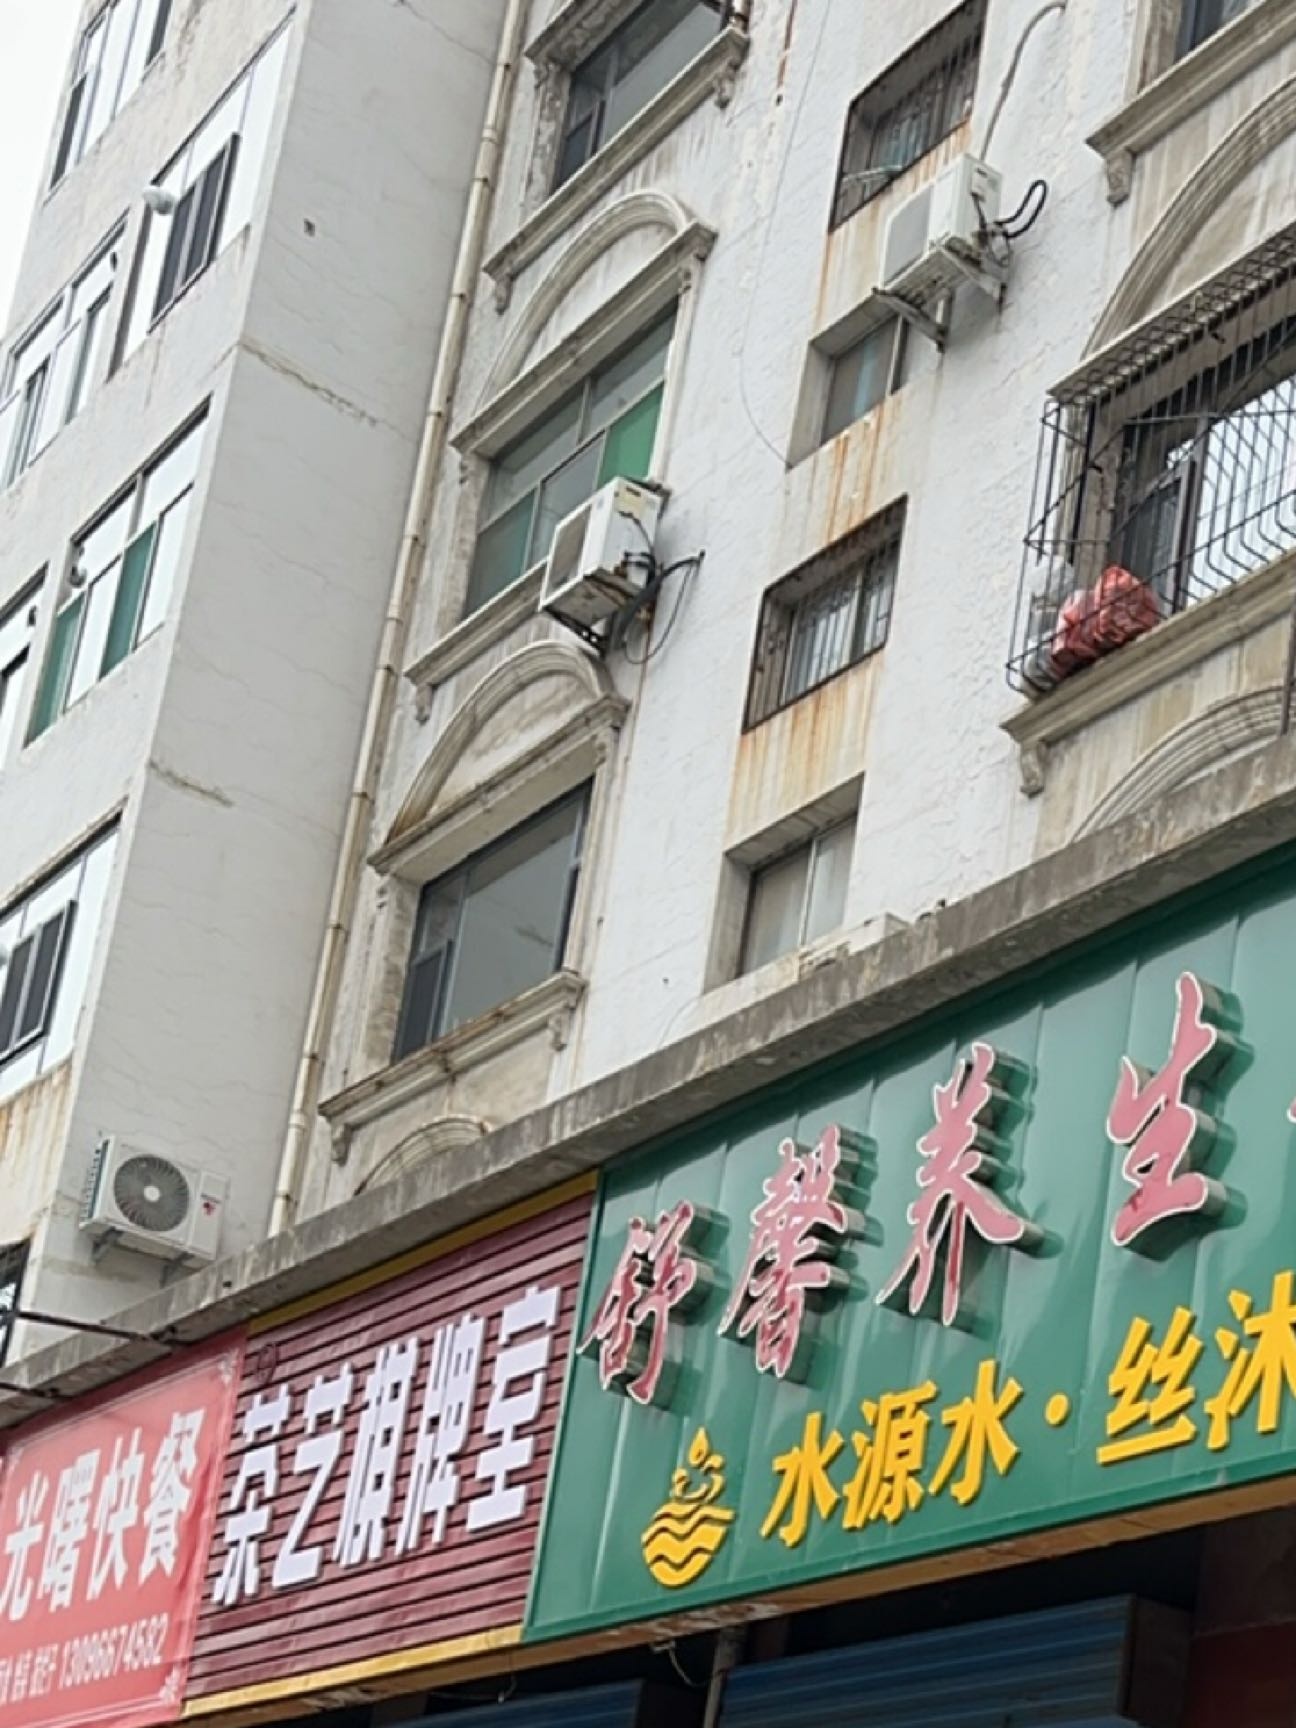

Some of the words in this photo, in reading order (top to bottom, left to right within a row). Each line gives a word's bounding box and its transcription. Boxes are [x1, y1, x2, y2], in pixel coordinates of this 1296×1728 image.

[212, 1285, 562, 1607] 茶艺棋牌室
